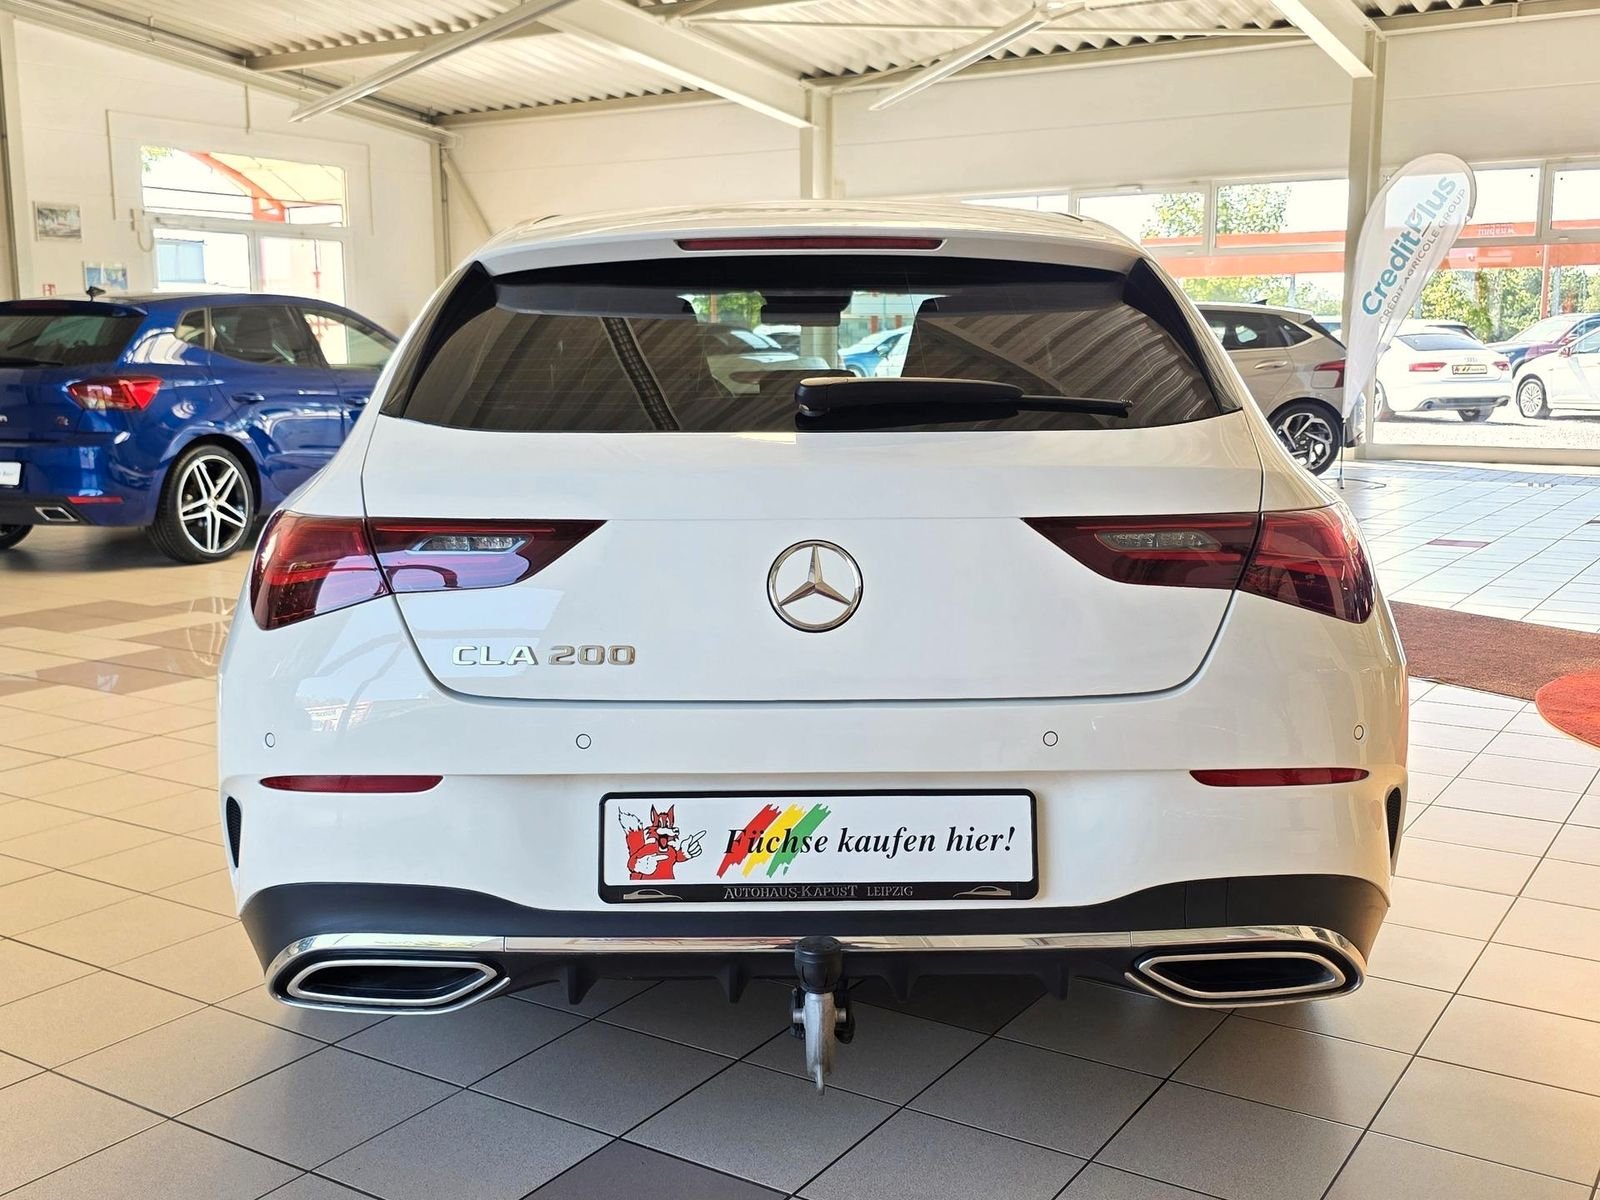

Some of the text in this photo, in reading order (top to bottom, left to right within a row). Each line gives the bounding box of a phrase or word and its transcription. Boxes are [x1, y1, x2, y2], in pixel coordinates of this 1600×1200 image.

[1362, 177, 1456, 315] CreditPlus
[1404, 230, 1440, 284] AGRICOLE
[1438, 188, 1465, 229] GROUP
[452, 645, 636, 666] CLA 200
[724, 825, 1017, 858] Füchse kaufen hier!
[866, 886, 914, 897] LEIPZIG
